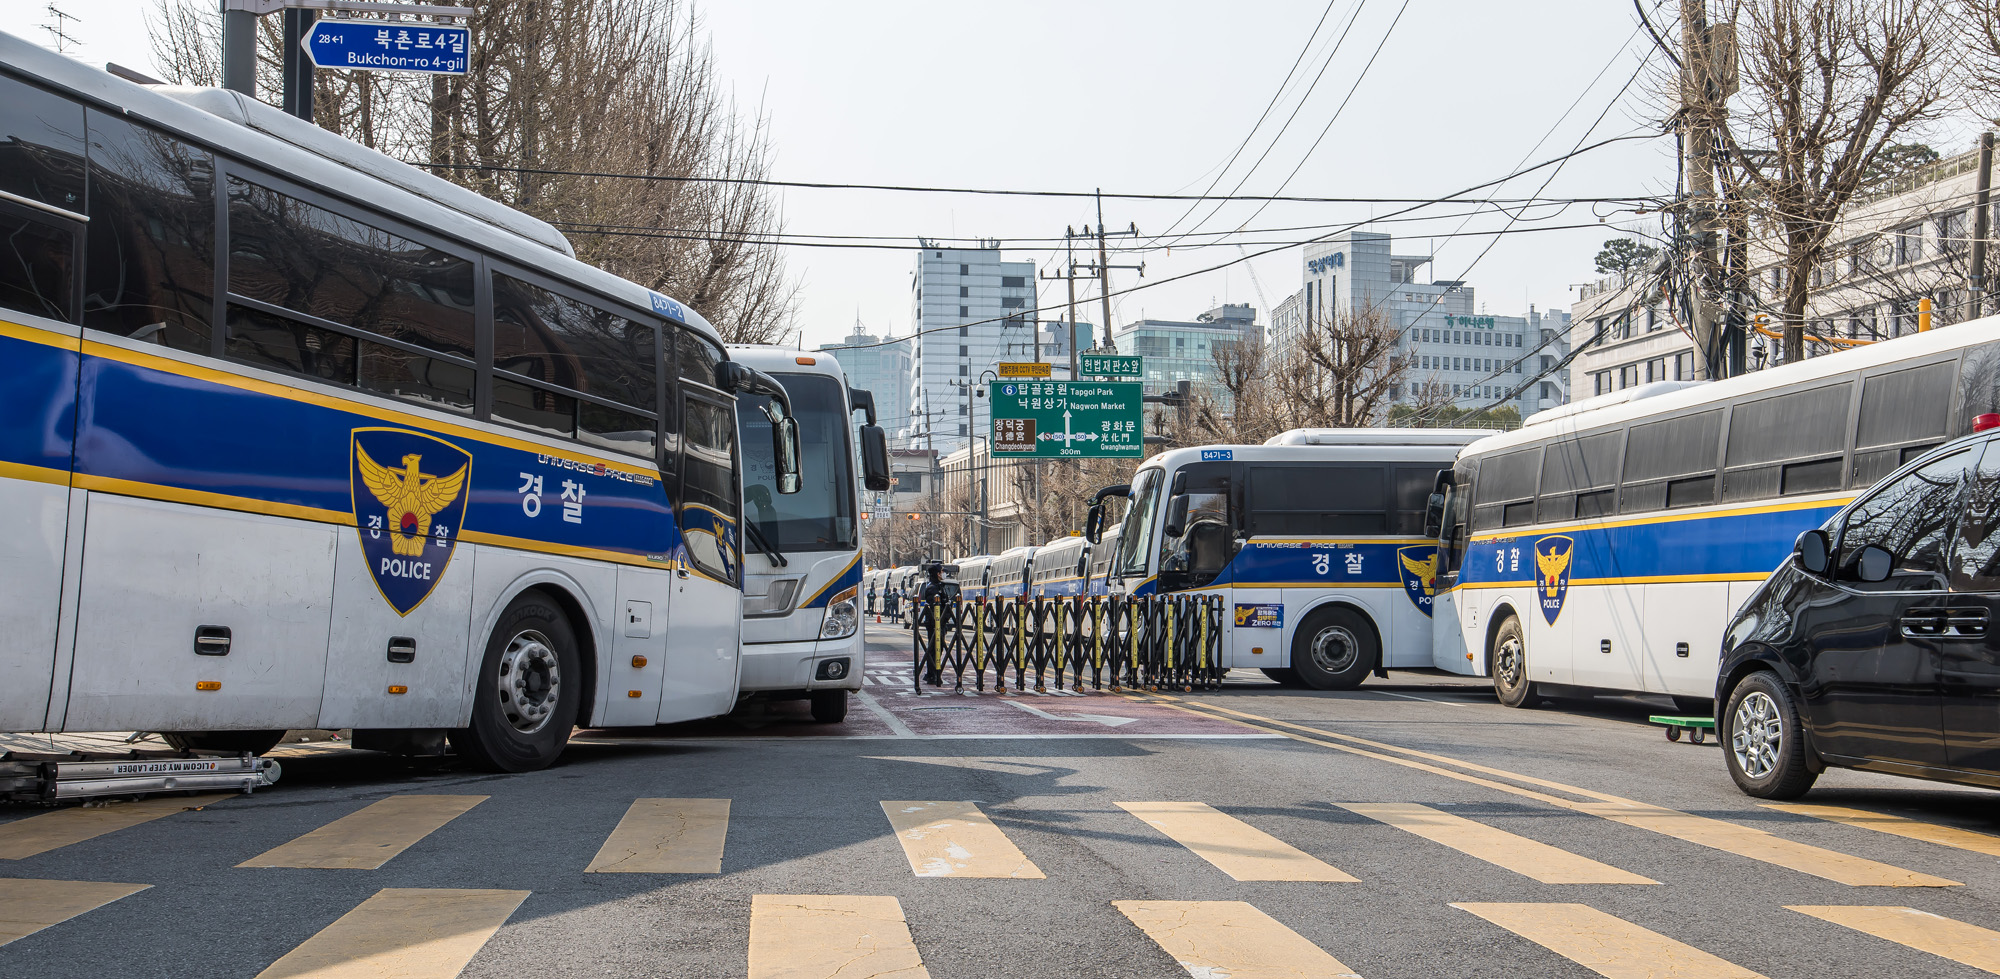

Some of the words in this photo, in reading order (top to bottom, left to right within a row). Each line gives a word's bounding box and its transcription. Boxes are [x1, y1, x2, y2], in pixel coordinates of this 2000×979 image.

[318, 34, 331, 44] 28
[374, 29, 464, 54] 북촌로4길
[347, 52, 428, 67] Bukchon-ro
[432, 56, 464, 71] 4-gil
[653, 296, 683, 319] 84기-2
[1459, 316, 1495, 330] 하나은행
[1020, 365, 1031, 374] CCTV
[1084, 358, 1139, 373] 헌법재판소앞
[1006, 385, 1013, 395] 6
[1018, 383, 1068, 396] 탑골공원
[1070, 388, 1095, 397] Tapgol
[1097, 388, 1113, 396] Park
[1018, 397, 1068, 410] 낙원상가
[1070, 403, 1099, 412] Nagwon
[995, 419, 1025, 431] 창덕궁
[1101, 420, 1136, 432] 광화문
[1101, 433, 1130, 442] 光化門
[995, 442, 1036, 451] Changdeokgung
[1100, 444, 1140, 452] Gwanghwamun
[1203, 451, 1232, 459] 84기-3
[368, 514, 382, 539] 경
[434, 524, 449, 548] 찰
[380, 557, 431, 580] POLICE
[1410, 580, 1419, 591] 경
[1543, 599, 1560, 609] POLICE
[117, 765, 147, 773] LADDER
[149, 763, 167, 772] STEP
[168, 762, 182, 771] MY
